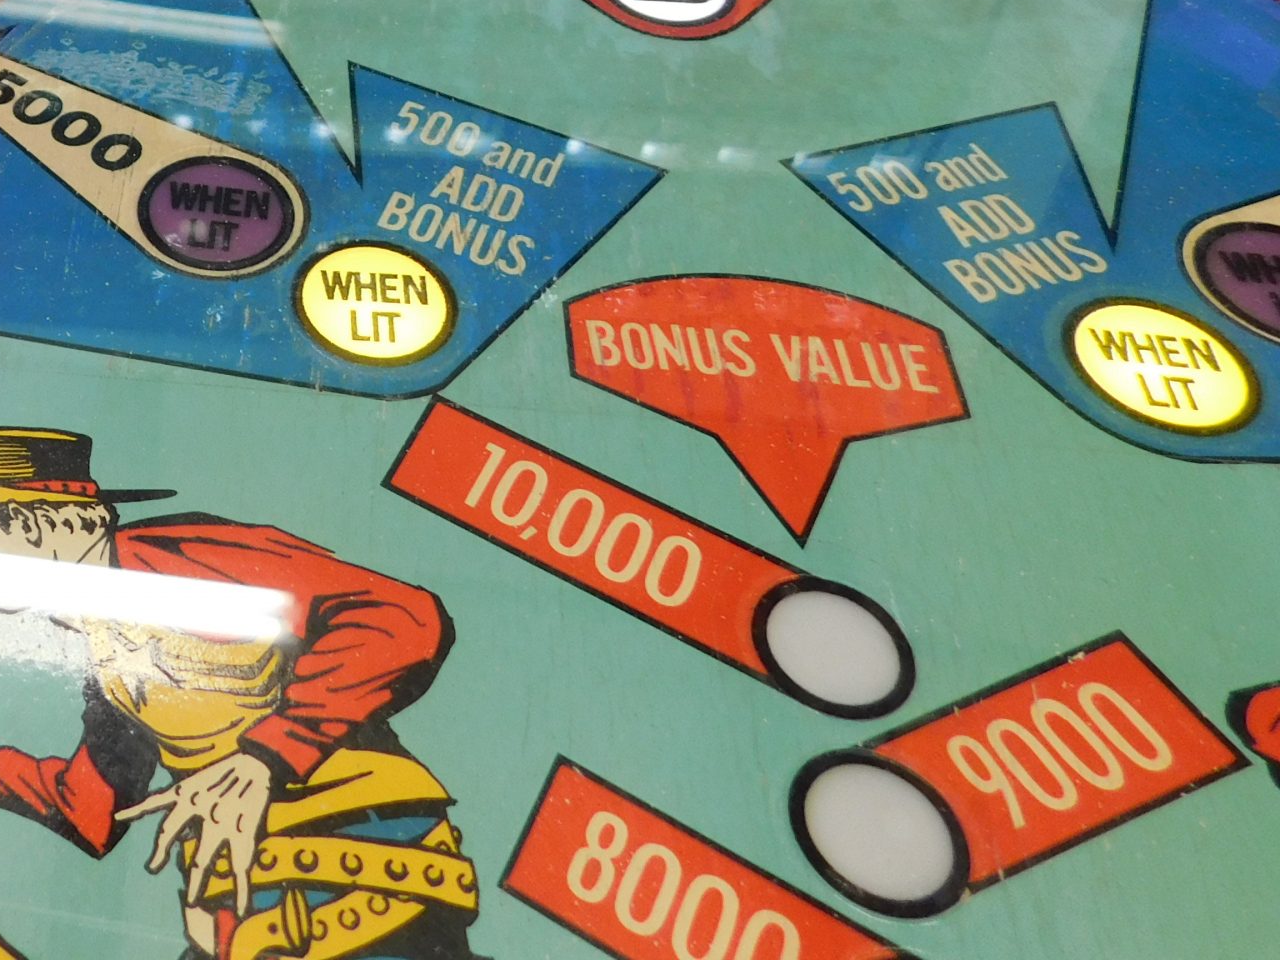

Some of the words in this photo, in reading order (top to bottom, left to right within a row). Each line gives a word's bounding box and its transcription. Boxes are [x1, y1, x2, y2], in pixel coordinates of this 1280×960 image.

[390, 102, 480, 156] 500
[483, 139, 565, 188] and
[169, 180, 270, 220] WHEN
[430, 167, 524, 224] ADD
[827, 160, 928, 213] 500
[925, 142, 1008, 190] and
[189, 219, 240, 252] LIT
[378, 192, 536, 277] BONUS
[937, 193, 1036, 249] ADD
[321, 270, 429, 307] WHEN
[942, 229, 1108, 304] BONUS
[351, 311, 402, 345] LIT
[584, 319, 757, 378] BONUS
[770, 334, 939, 394] VALUE
[1087, 326, 1221, 373] WHEN
[1141, 375, 1199, 411] LIT
[463, 442, 702, 607] 10,000
[946, 681, 1173, 830] 9000
[567, 810, 801, 960] 8000
